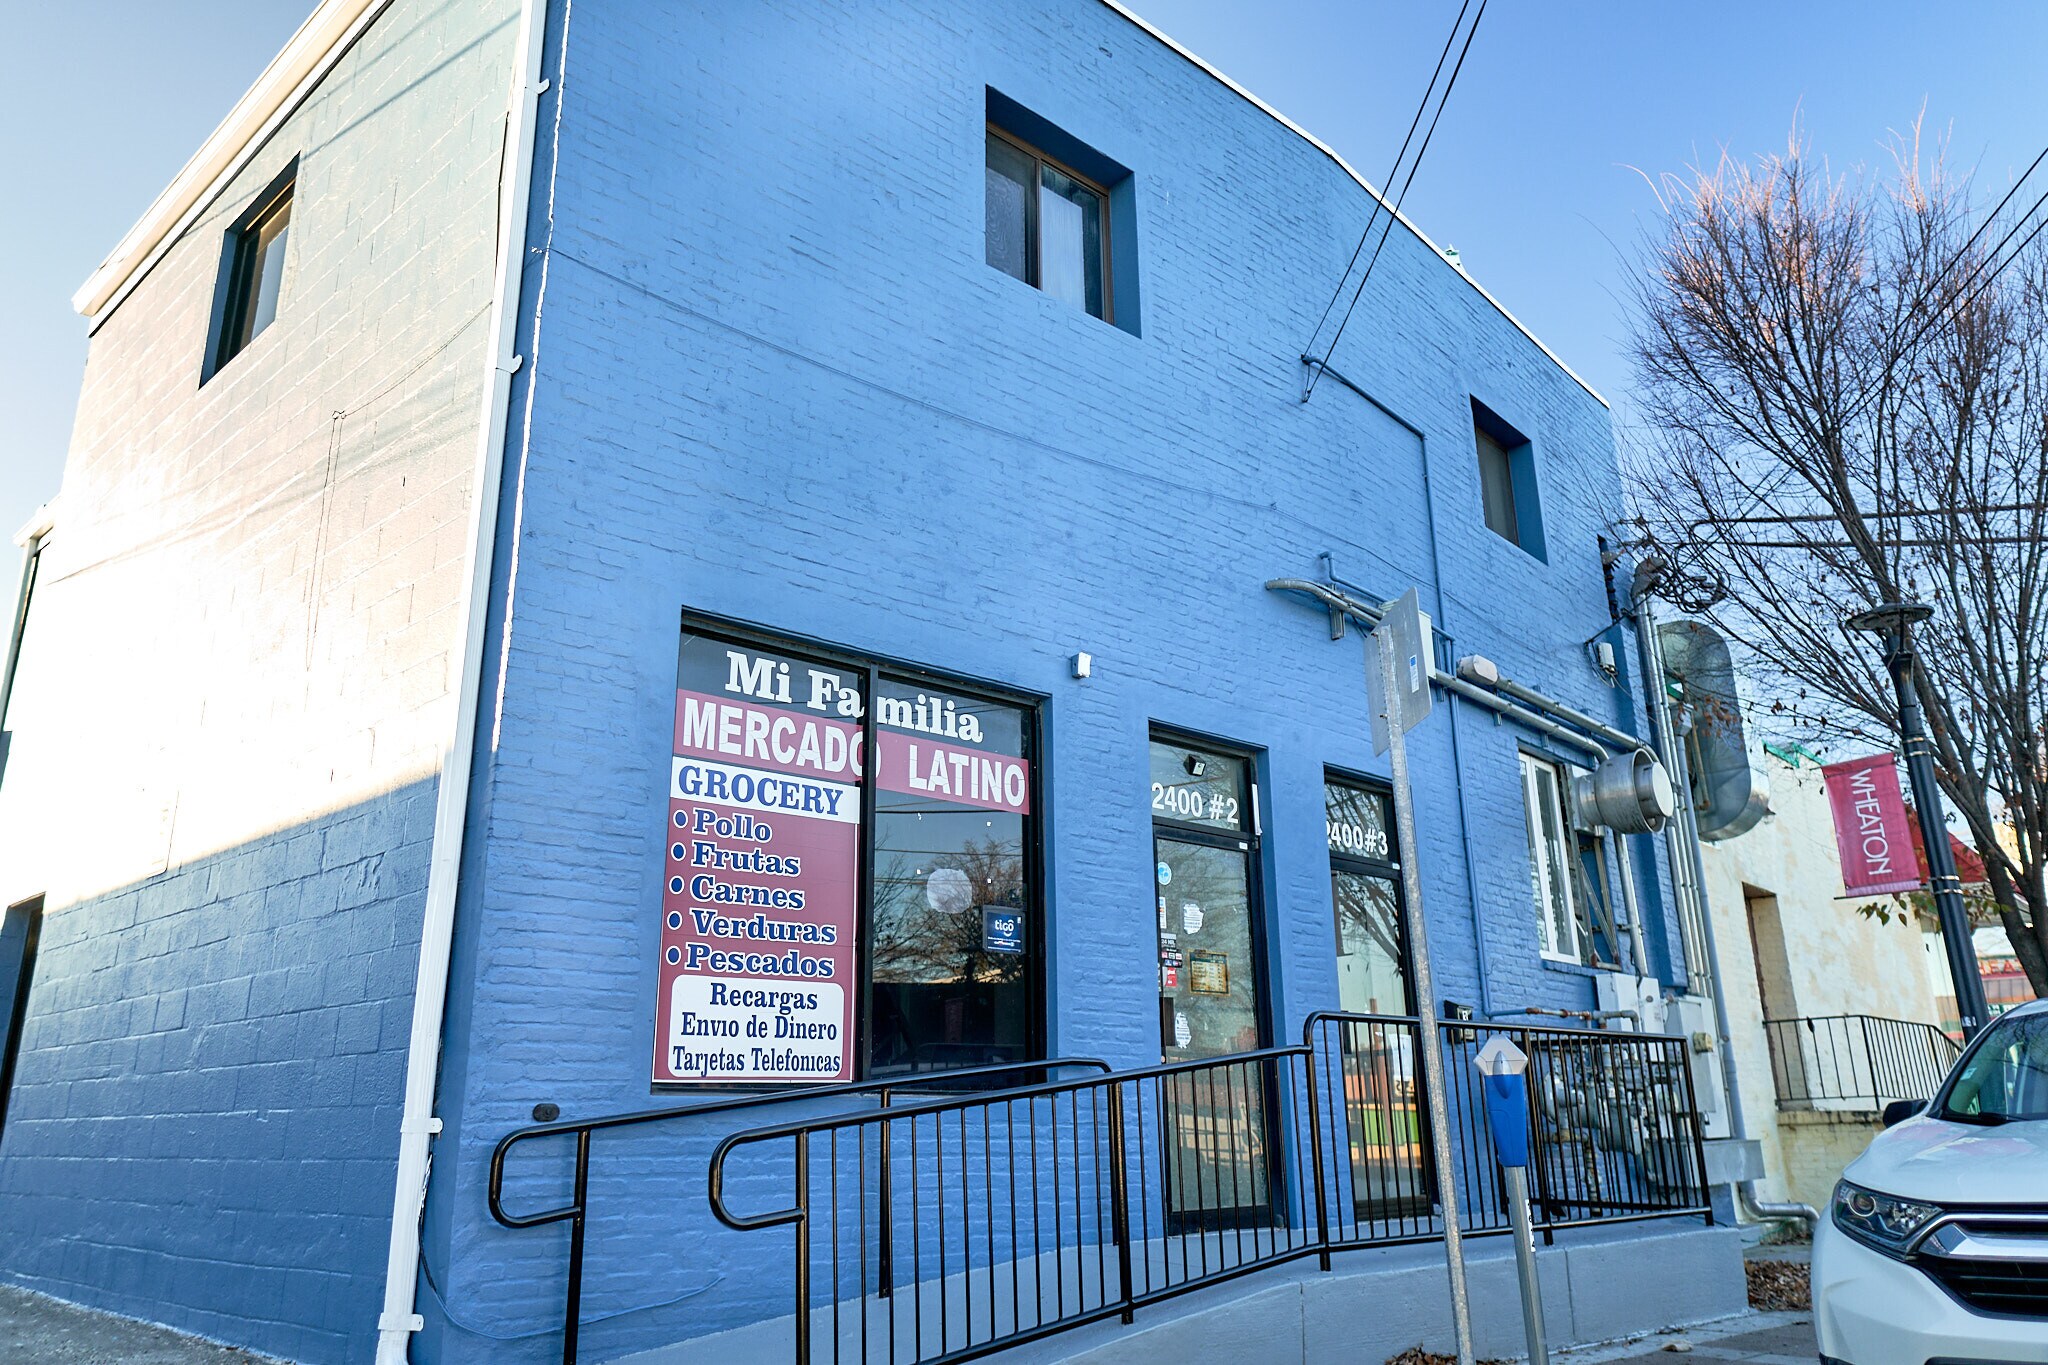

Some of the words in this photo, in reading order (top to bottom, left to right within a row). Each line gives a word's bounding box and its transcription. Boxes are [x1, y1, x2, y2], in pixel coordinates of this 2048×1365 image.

[725, 650, 793, 704] Mi
[806, 669, 984, 743] Familia
[682, 698, 882, 779] MERCADO
[908, 745, 1026, 807] LATINO
[678, 766, 843, 816] GROCERY
[1151, 782, 1203, 817] 2400
[1208, 794, 1239, 824] #2
[691, 807, 773, 843] Pollo
[1850, 768, 1893, 875] WHEATON
[690, 840, 801, 876] Frutas
[689, 874, 806, 910] Carnes
[689, 908, 837, 945] Verduras
[684, 943, 835, 979] Pescados
[709, 982, 819, 1015] Recargas
[681, 1011, 740, 1038] Envio
[746, 1015, 769, 1039] de
[774, 1015, 838, 1041] Dinero
[672, 1045, 745, 1078] Tarjetas
[751, 1047, 842, 1072] Telefonicas
